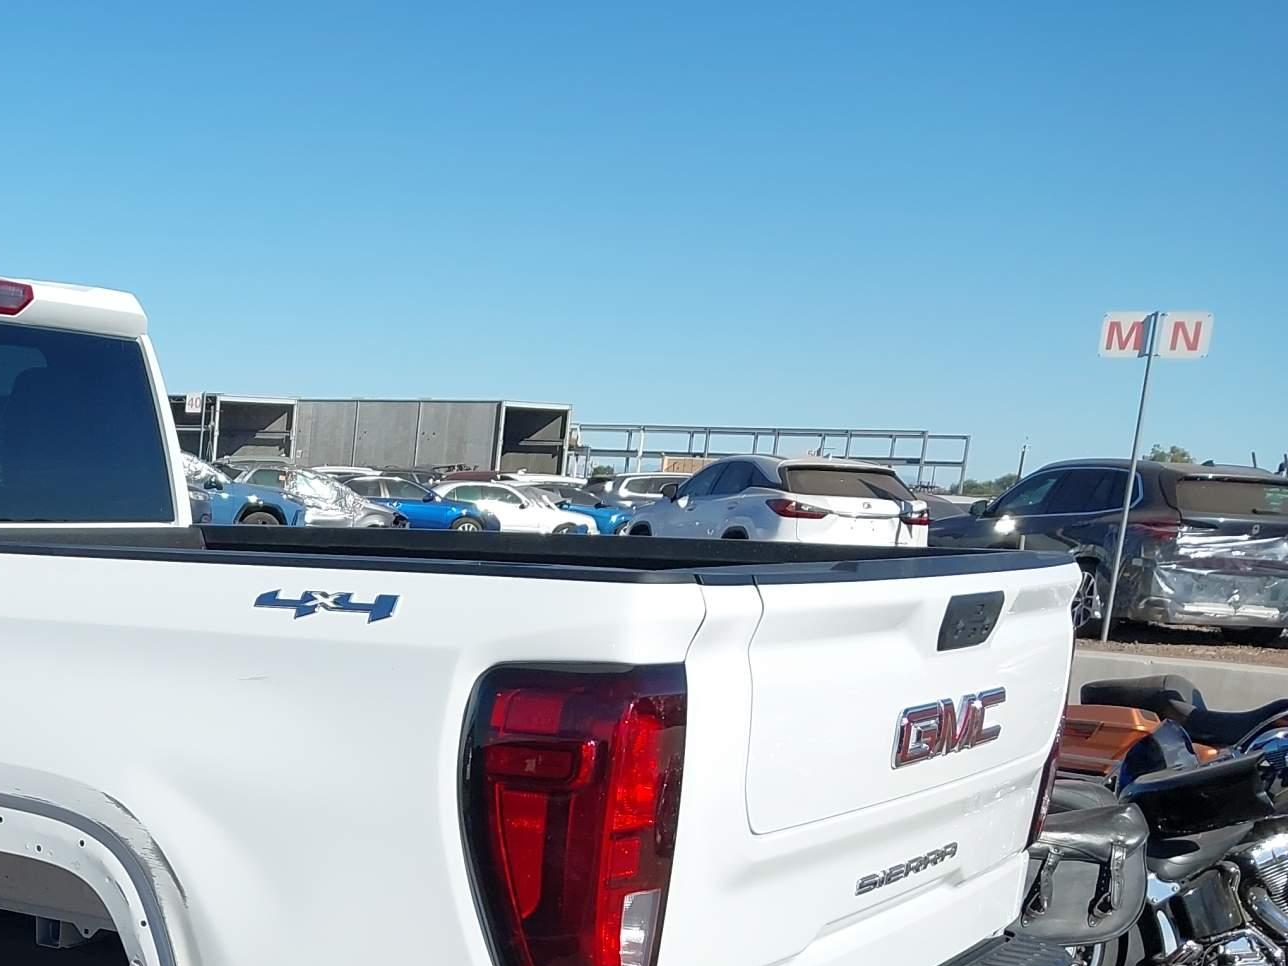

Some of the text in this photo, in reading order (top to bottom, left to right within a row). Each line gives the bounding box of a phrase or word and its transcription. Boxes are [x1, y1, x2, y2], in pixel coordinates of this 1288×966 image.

[1105, 320, 1202, 351] M N
[187, 396, 201, 409] 40
[890, 686, 1006, 770] GMC
[854, 841, 959, 897] SIERRA
